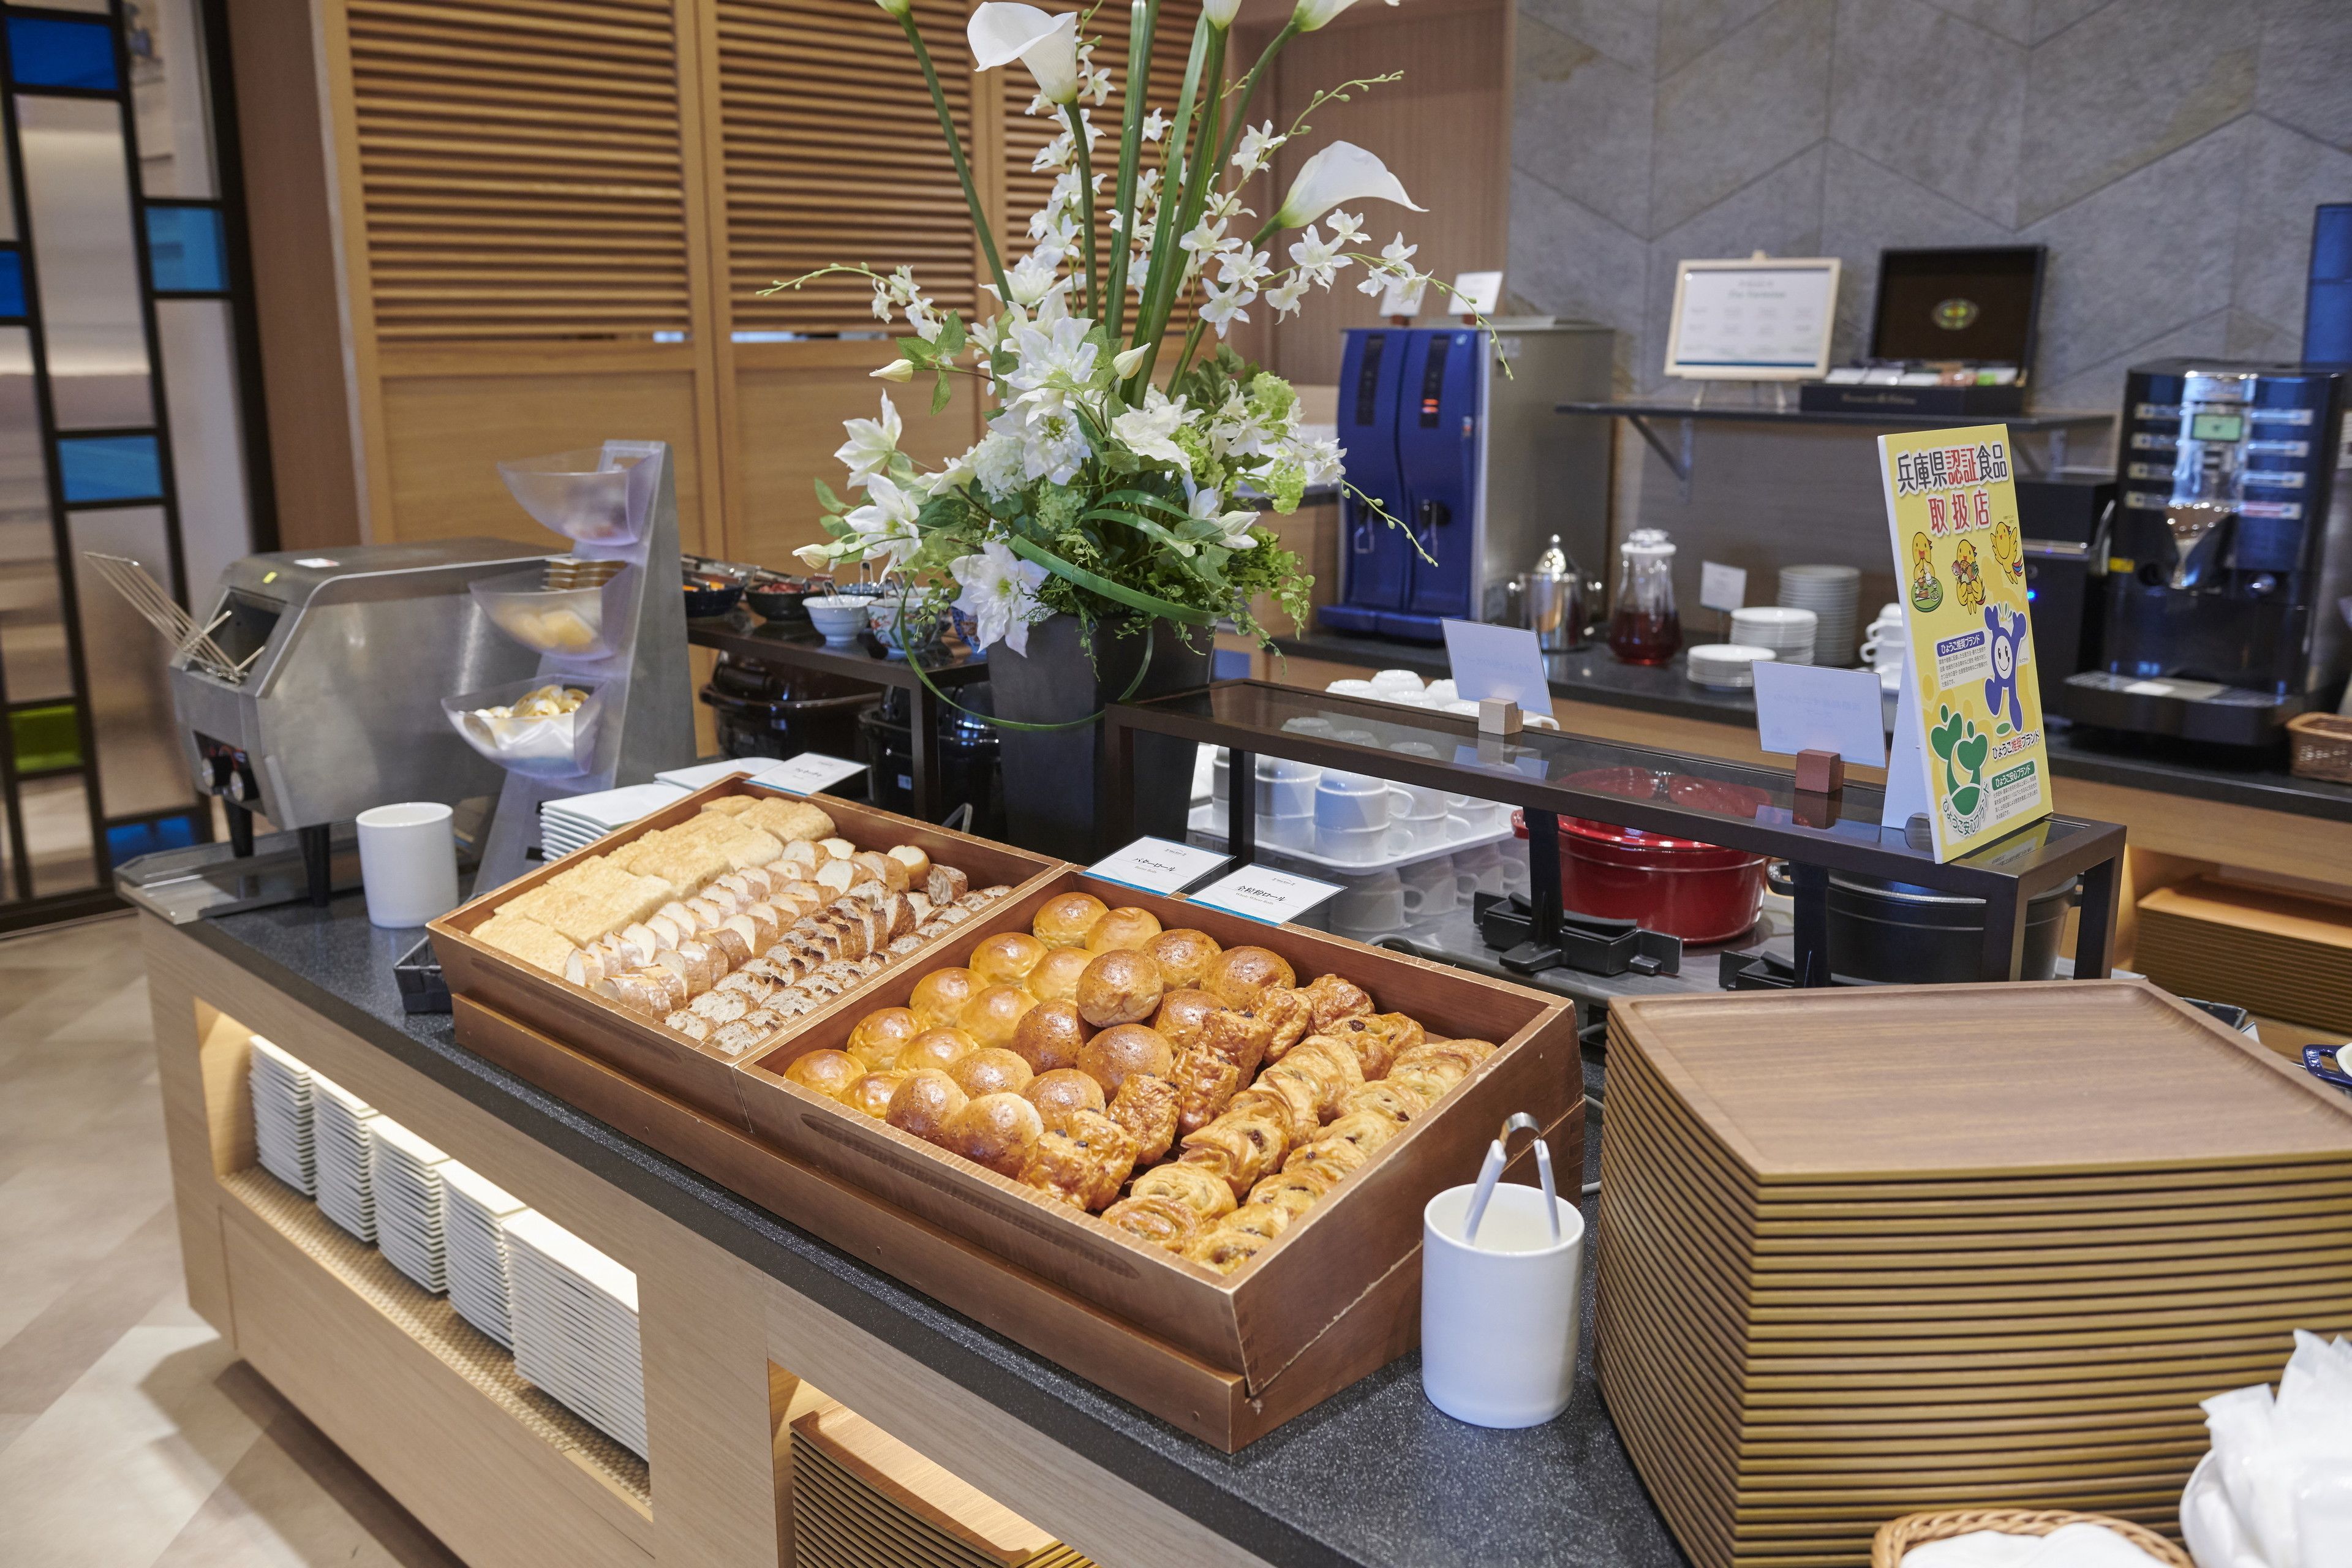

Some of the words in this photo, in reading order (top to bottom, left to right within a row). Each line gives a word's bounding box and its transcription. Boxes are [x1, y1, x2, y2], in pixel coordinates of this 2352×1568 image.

[1898, 444, 2008, 493] 兵庫県認証食品
[1928, 489, 1990, 533] 取扱店
[1941, 635, 1980, 654] ひょうご推奨ブランド
[1992, 731, 2040, 759] ひょうご推奨ブランド
[1996, 764, 2030, 787] ひょうご安心ブランド
[1943, 780, 1989, 835] ひょうご安心ブランド
[1133, 858, 1176, 872] バターロール
[1237, 885, 1286, 902] 全粒粉ロール
